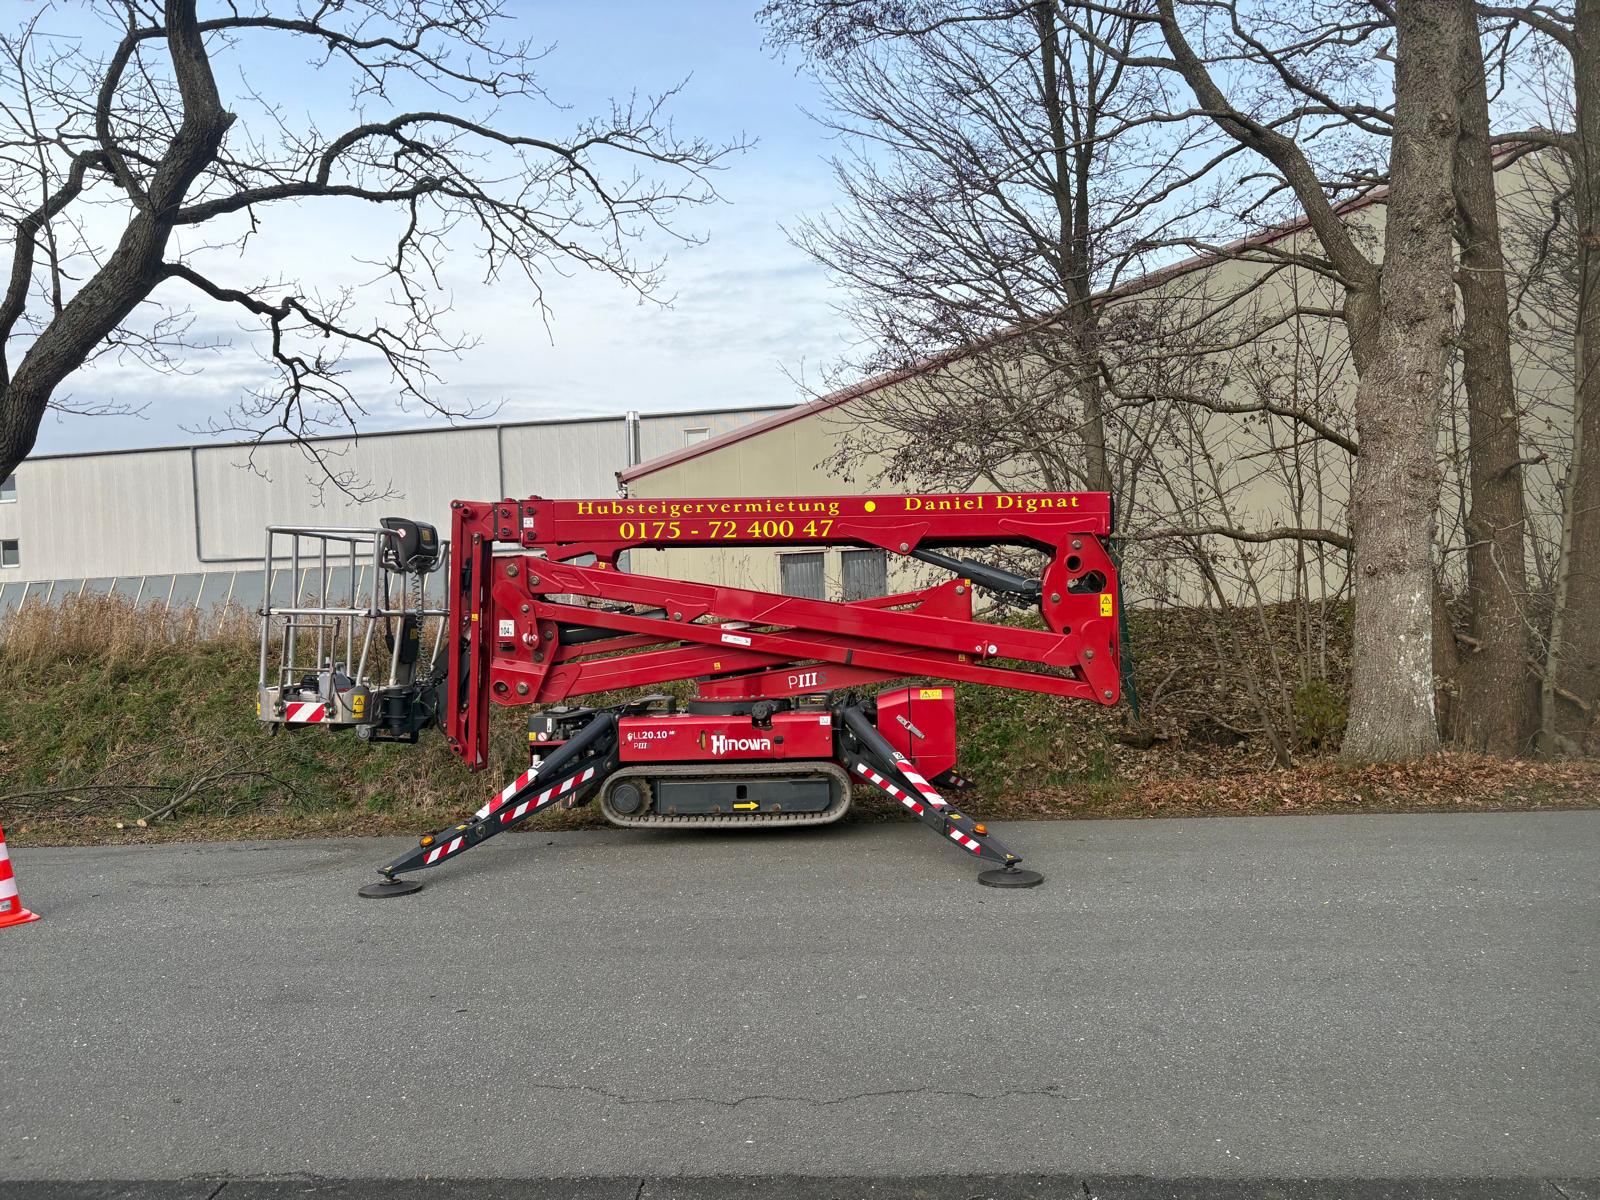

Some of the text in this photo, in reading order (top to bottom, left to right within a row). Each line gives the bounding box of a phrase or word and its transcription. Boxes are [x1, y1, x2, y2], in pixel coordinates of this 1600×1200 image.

[577, 495, 1079, 518] Hubsteigervermietung Daniel Dignat
[619, 521, 681, 539] 0175
[708, 521, 737, 539] 72
[747, 520, 794, 538] 400
[803, 519, 834, 537] 47
[711, 735, 771, 755] Hinowa
